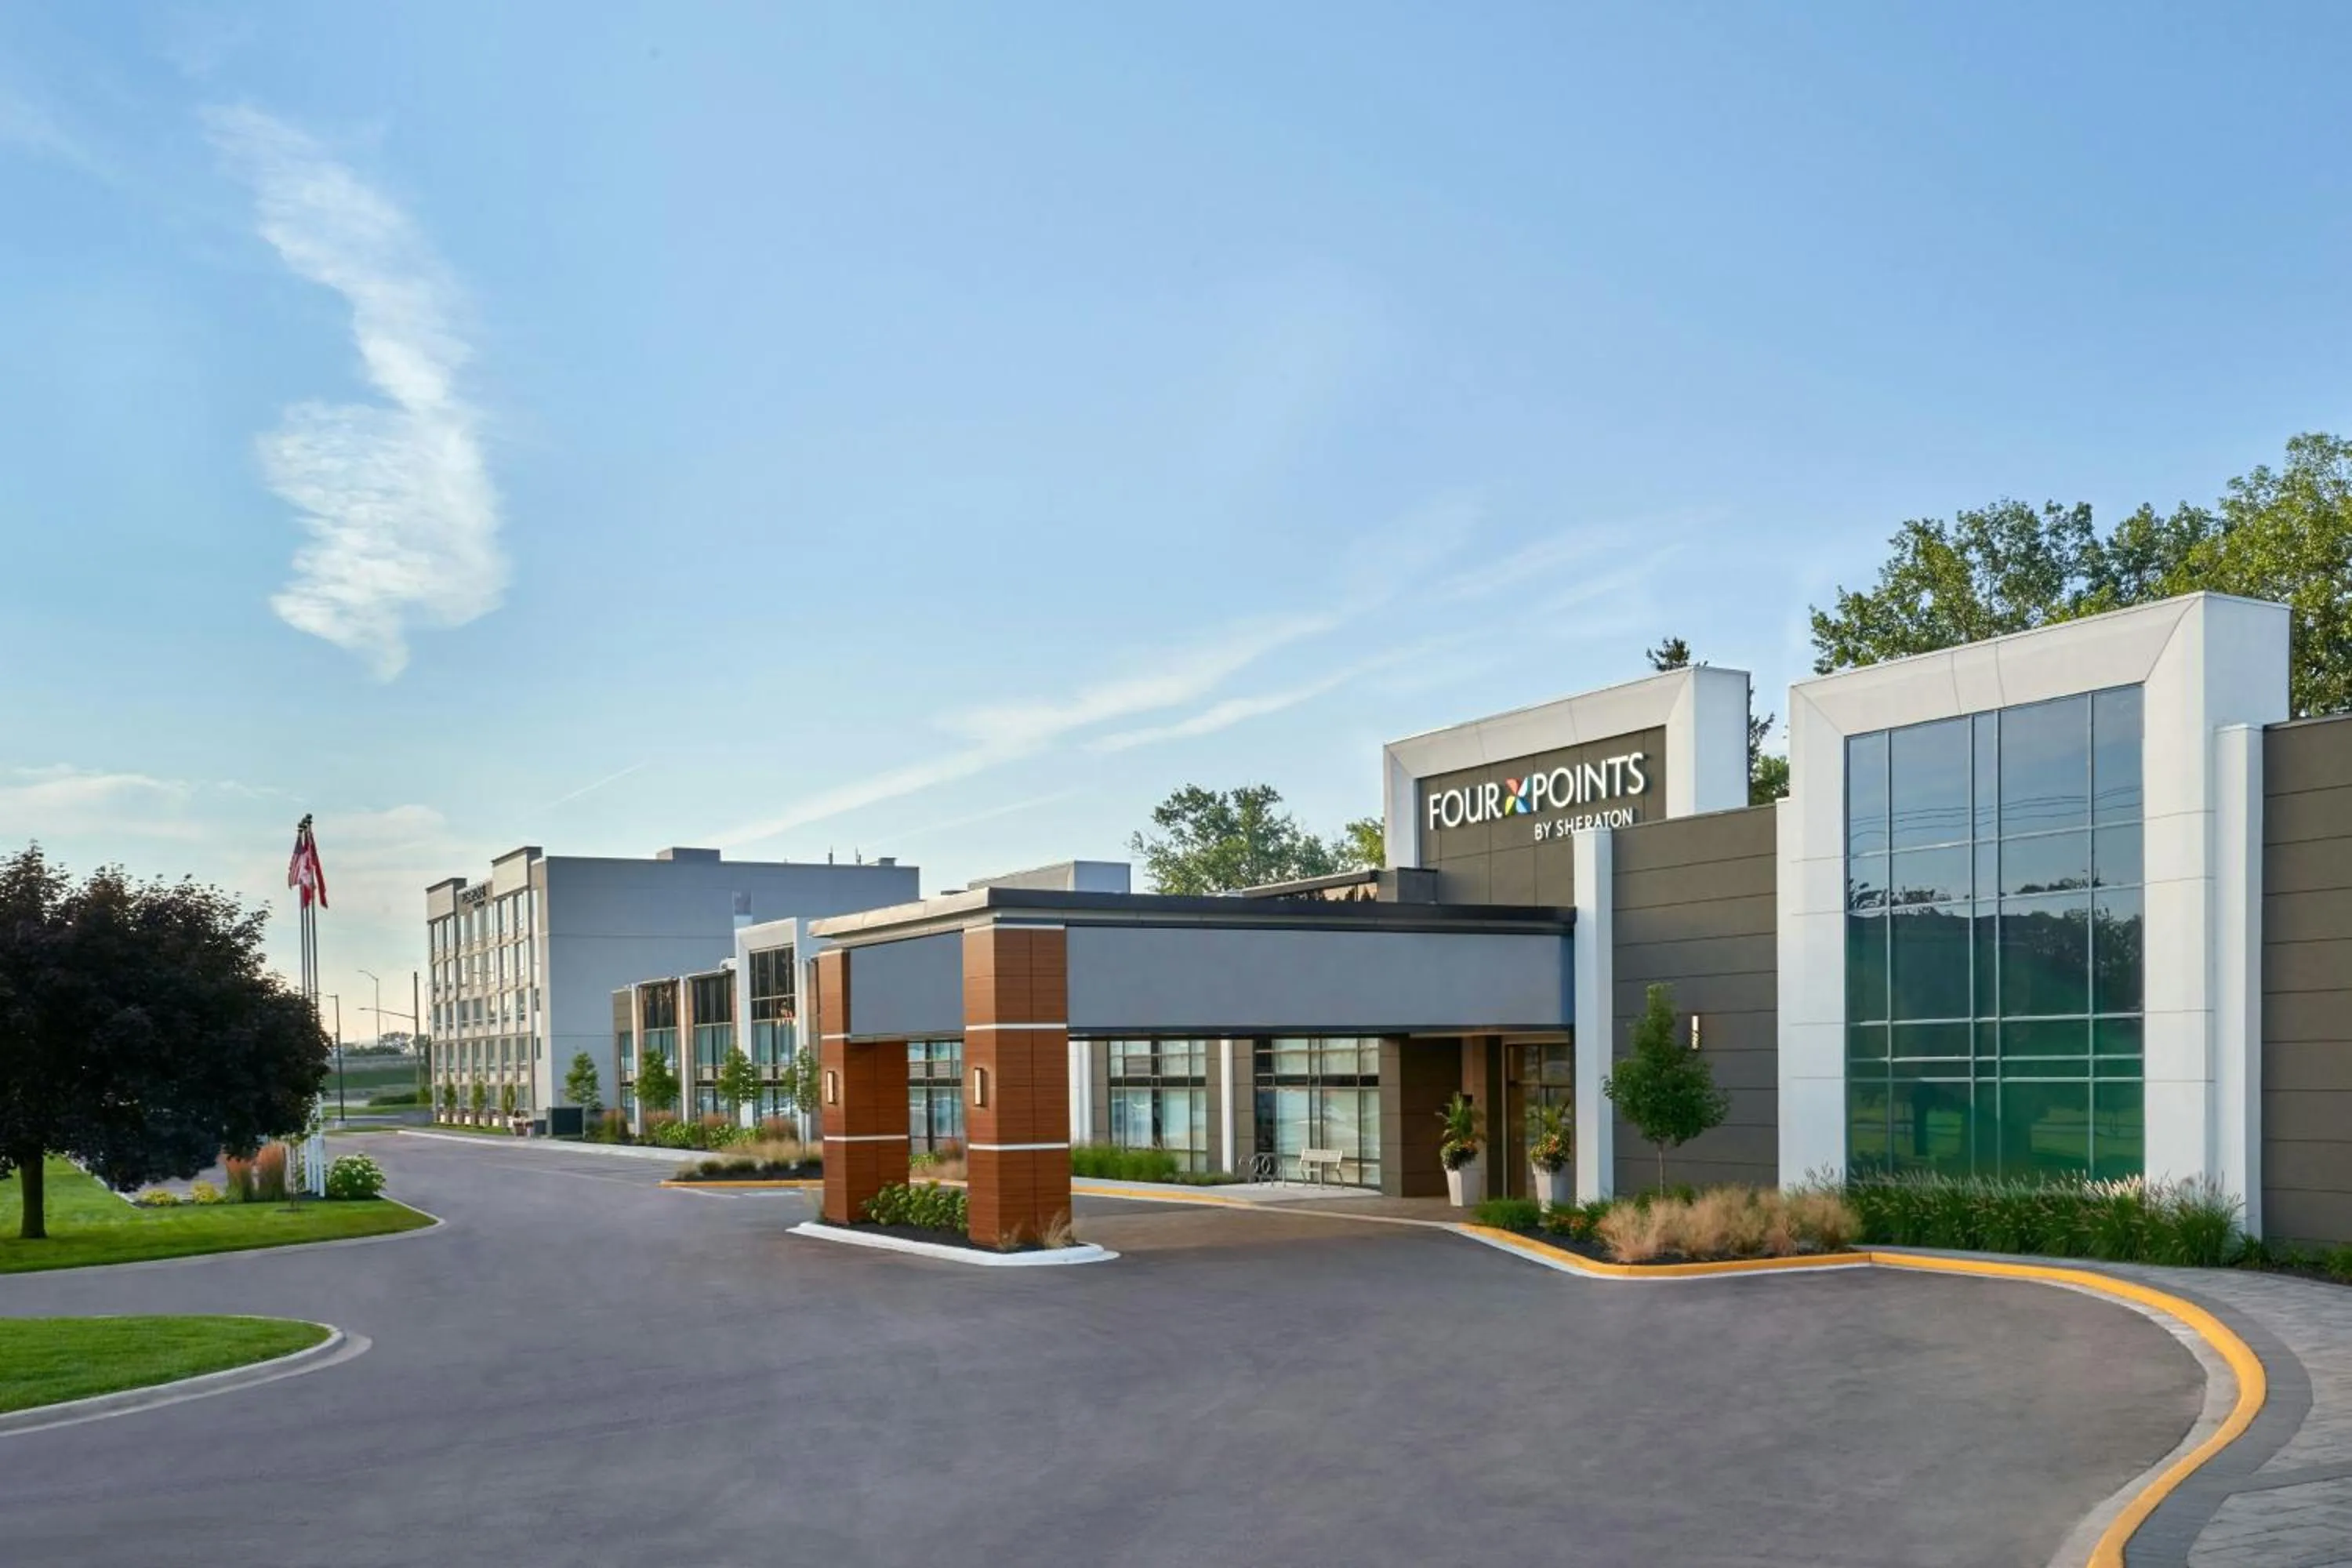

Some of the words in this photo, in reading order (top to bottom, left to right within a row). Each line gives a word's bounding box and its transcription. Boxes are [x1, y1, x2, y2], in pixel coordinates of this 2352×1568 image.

[1429, 783, 1502, 830] FOUR
[1533, 752, 1645, 811] POINTS
[1534, 821, 1552, 840] BY
[1556, 808, 1633, 837] SHERATON
